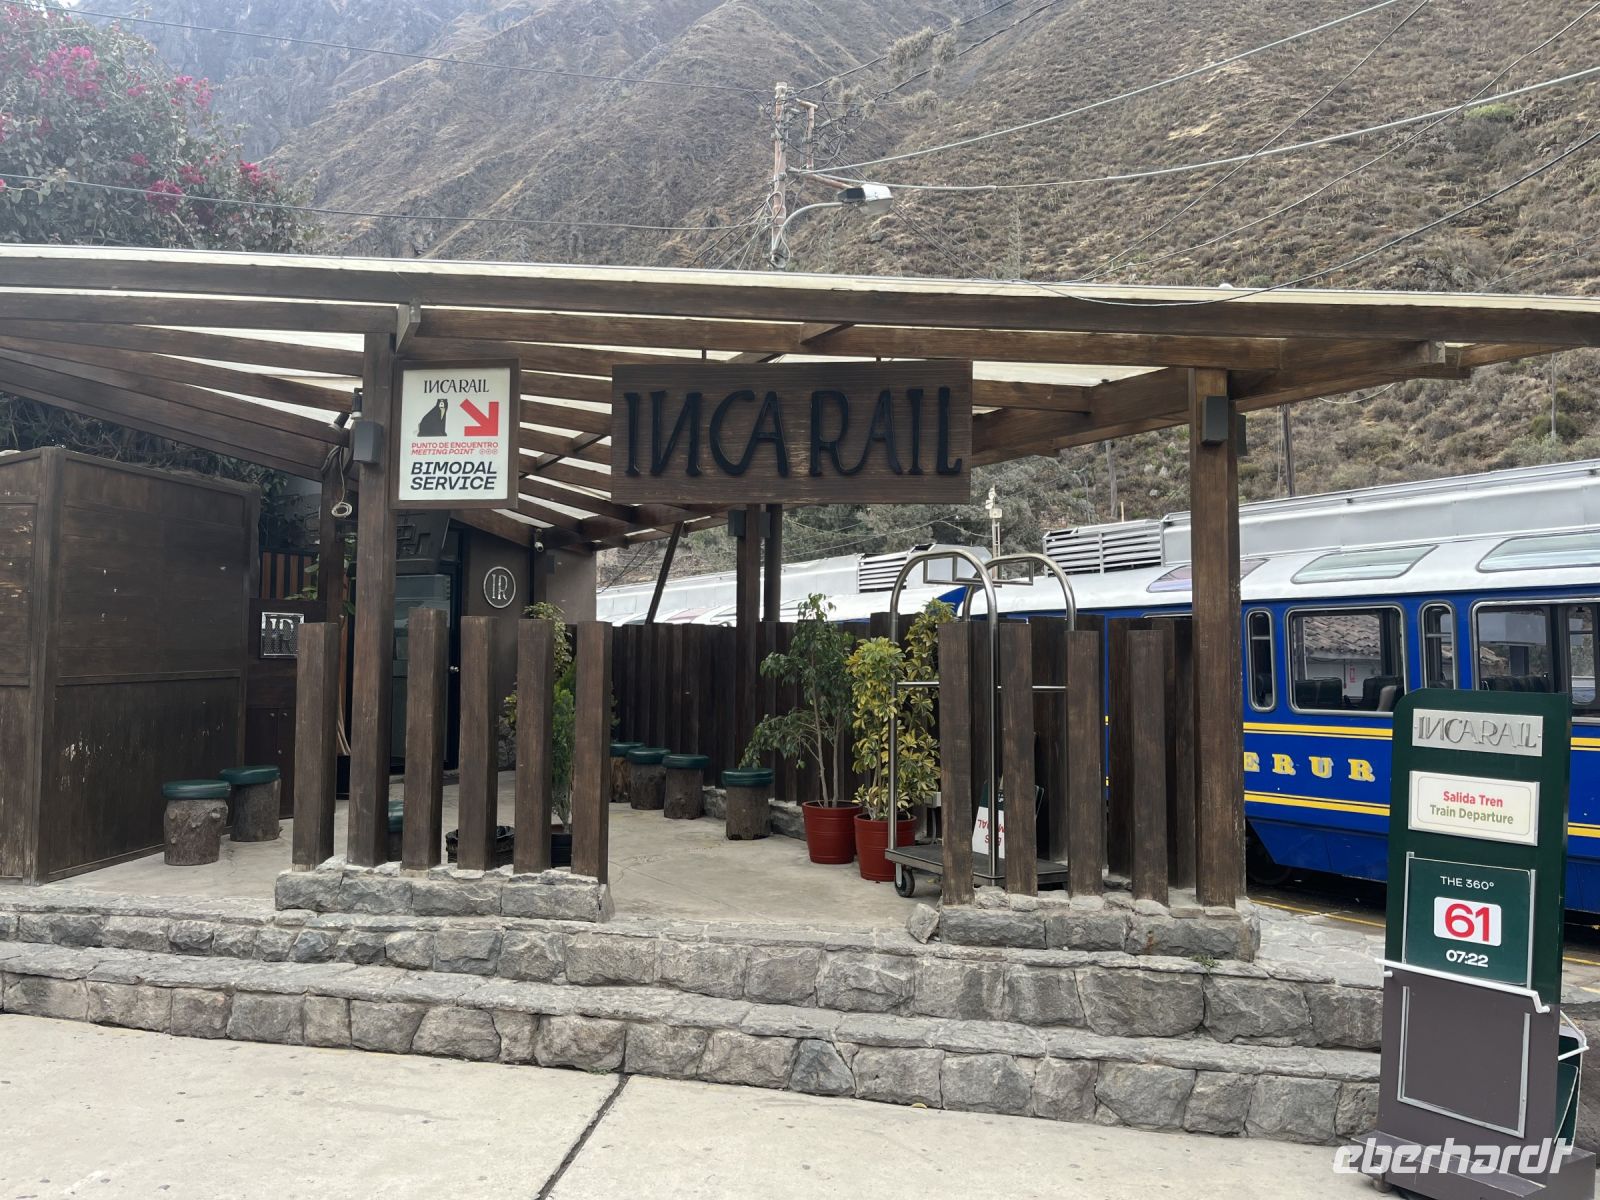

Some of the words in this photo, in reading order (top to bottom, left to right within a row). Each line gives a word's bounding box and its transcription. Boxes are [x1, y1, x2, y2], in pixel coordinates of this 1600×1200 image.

[411, 461, 497, 475] BIMODAL
[410, 476, 497, 490] SERVICE
[1443, 790, 1476, 805] Salida
[1478, 793, 1503, 808] Tren
[1429, 804, 1456, 819] Train
[1458, 808, 1513, 826] Departure
[1440, 875, 1463, 887] THE
[1444, 903, 1490, 943] 61
[1445, 949, 1488, 968] 07:22
